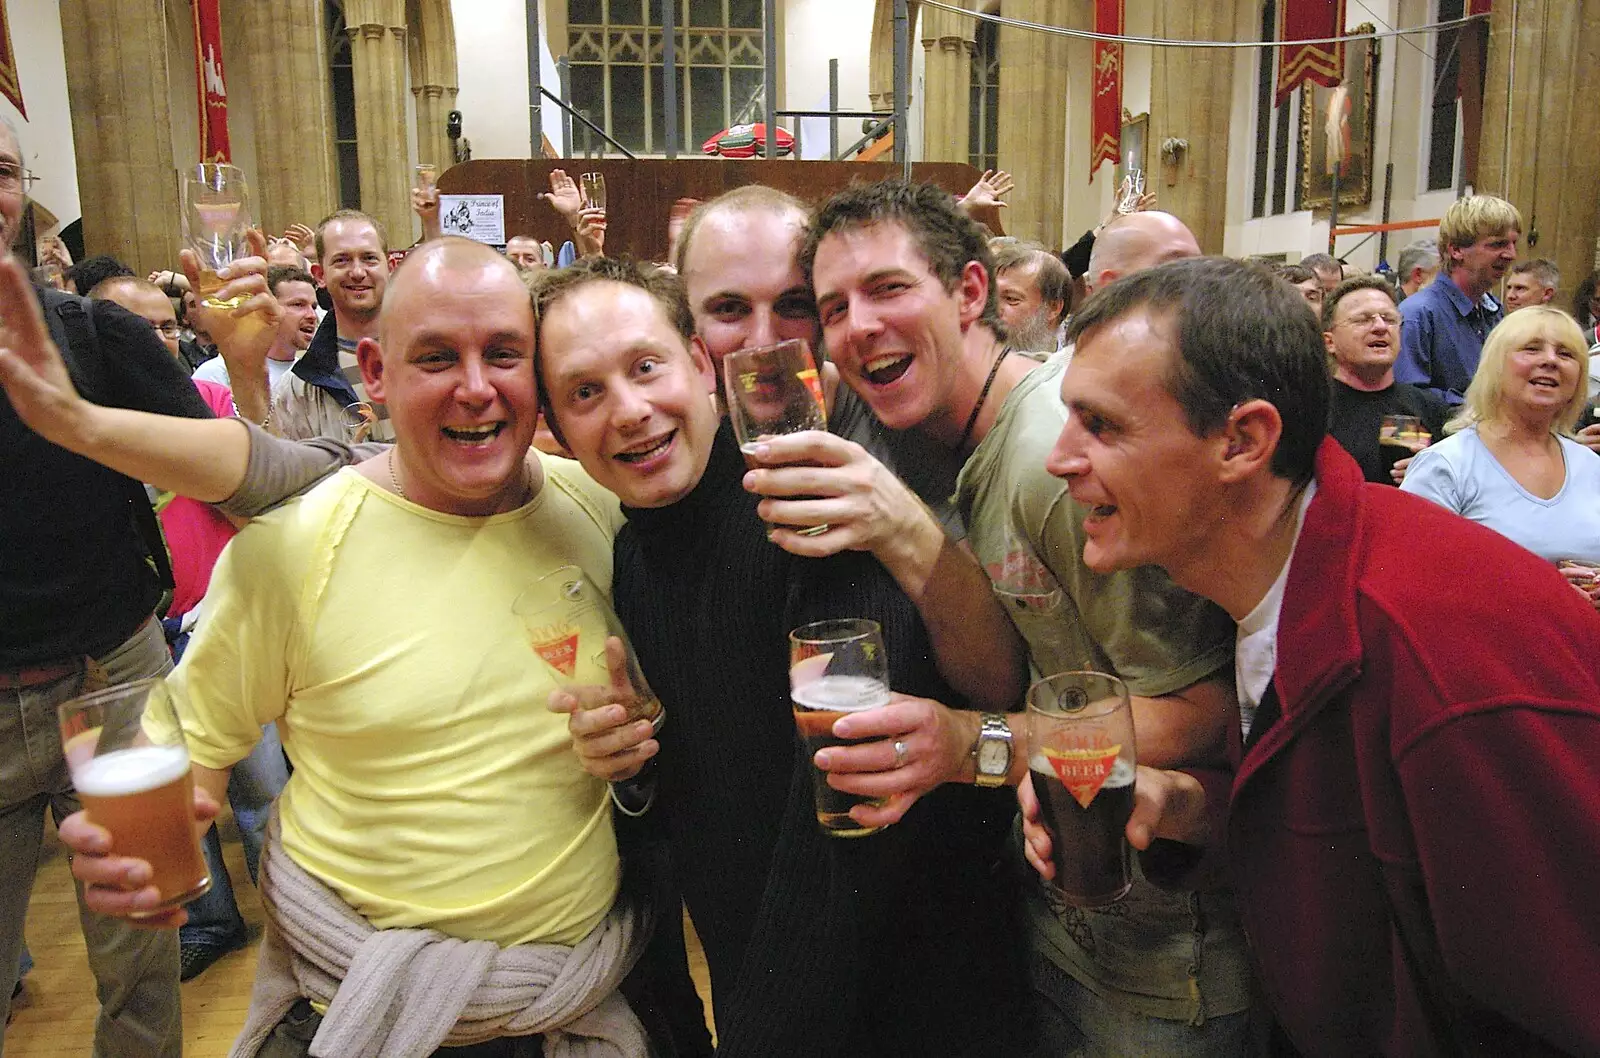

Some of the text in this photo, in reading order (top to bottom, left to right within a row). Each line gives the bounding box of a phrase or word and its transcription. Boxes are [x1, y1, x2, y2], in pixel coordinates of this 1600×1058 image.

[491, 199, 499, 209] of
[543, 645, 574, 660] BEER
[1060, 764, 1105, 776] BEER
